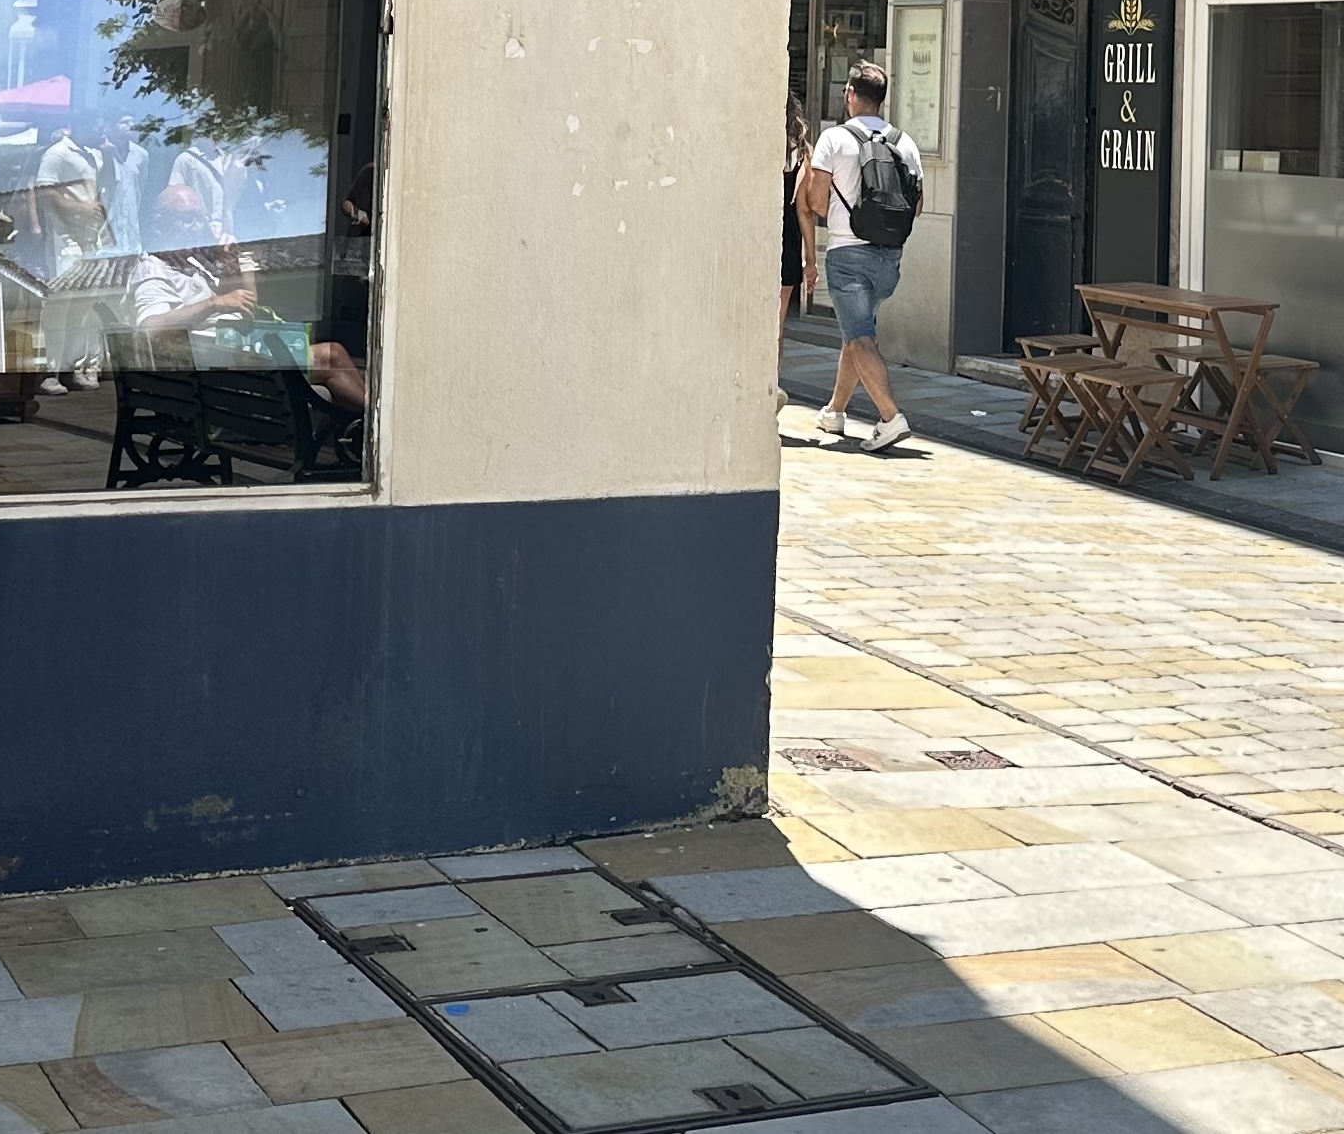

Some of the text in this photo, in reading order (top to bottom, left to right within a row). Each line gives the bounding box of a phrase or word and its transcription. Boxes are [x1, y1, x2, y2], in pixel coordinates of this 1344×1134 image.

[1105, 43, 1155, 83] GRILL
[1120, 90, 1136, 123] &
[1100, 129, 1155, 171] GRAIN
